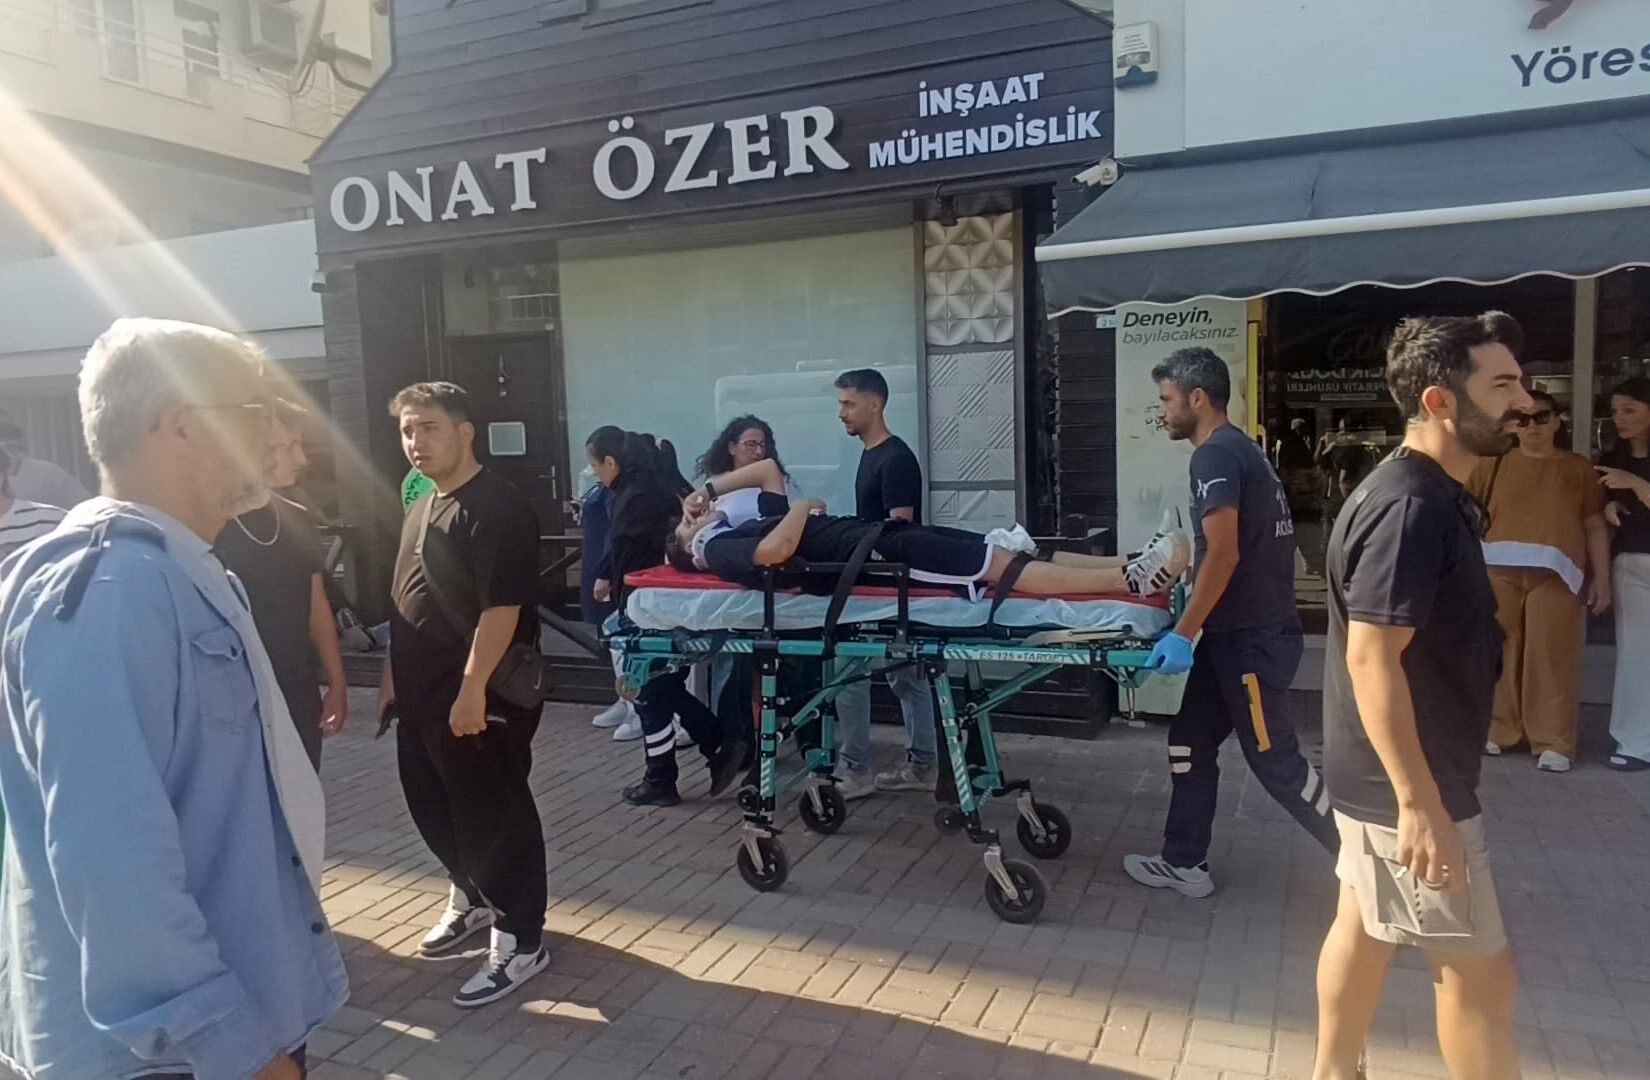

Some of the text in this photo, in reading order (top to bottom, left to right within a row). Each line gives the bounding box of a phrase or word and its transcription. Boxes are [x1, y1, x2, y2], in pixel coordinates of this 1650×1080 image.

[919, 72, 1044, 118] İNŞAAT
[869, 106, 1102, 169] MÜHENDİSLİK
[330, 106, 849, 232] ONAT ÖZER
[1122, 327, 1239, 346] bayılacaksınız.
[1123, 307, 1213, 328] Deneyin,
